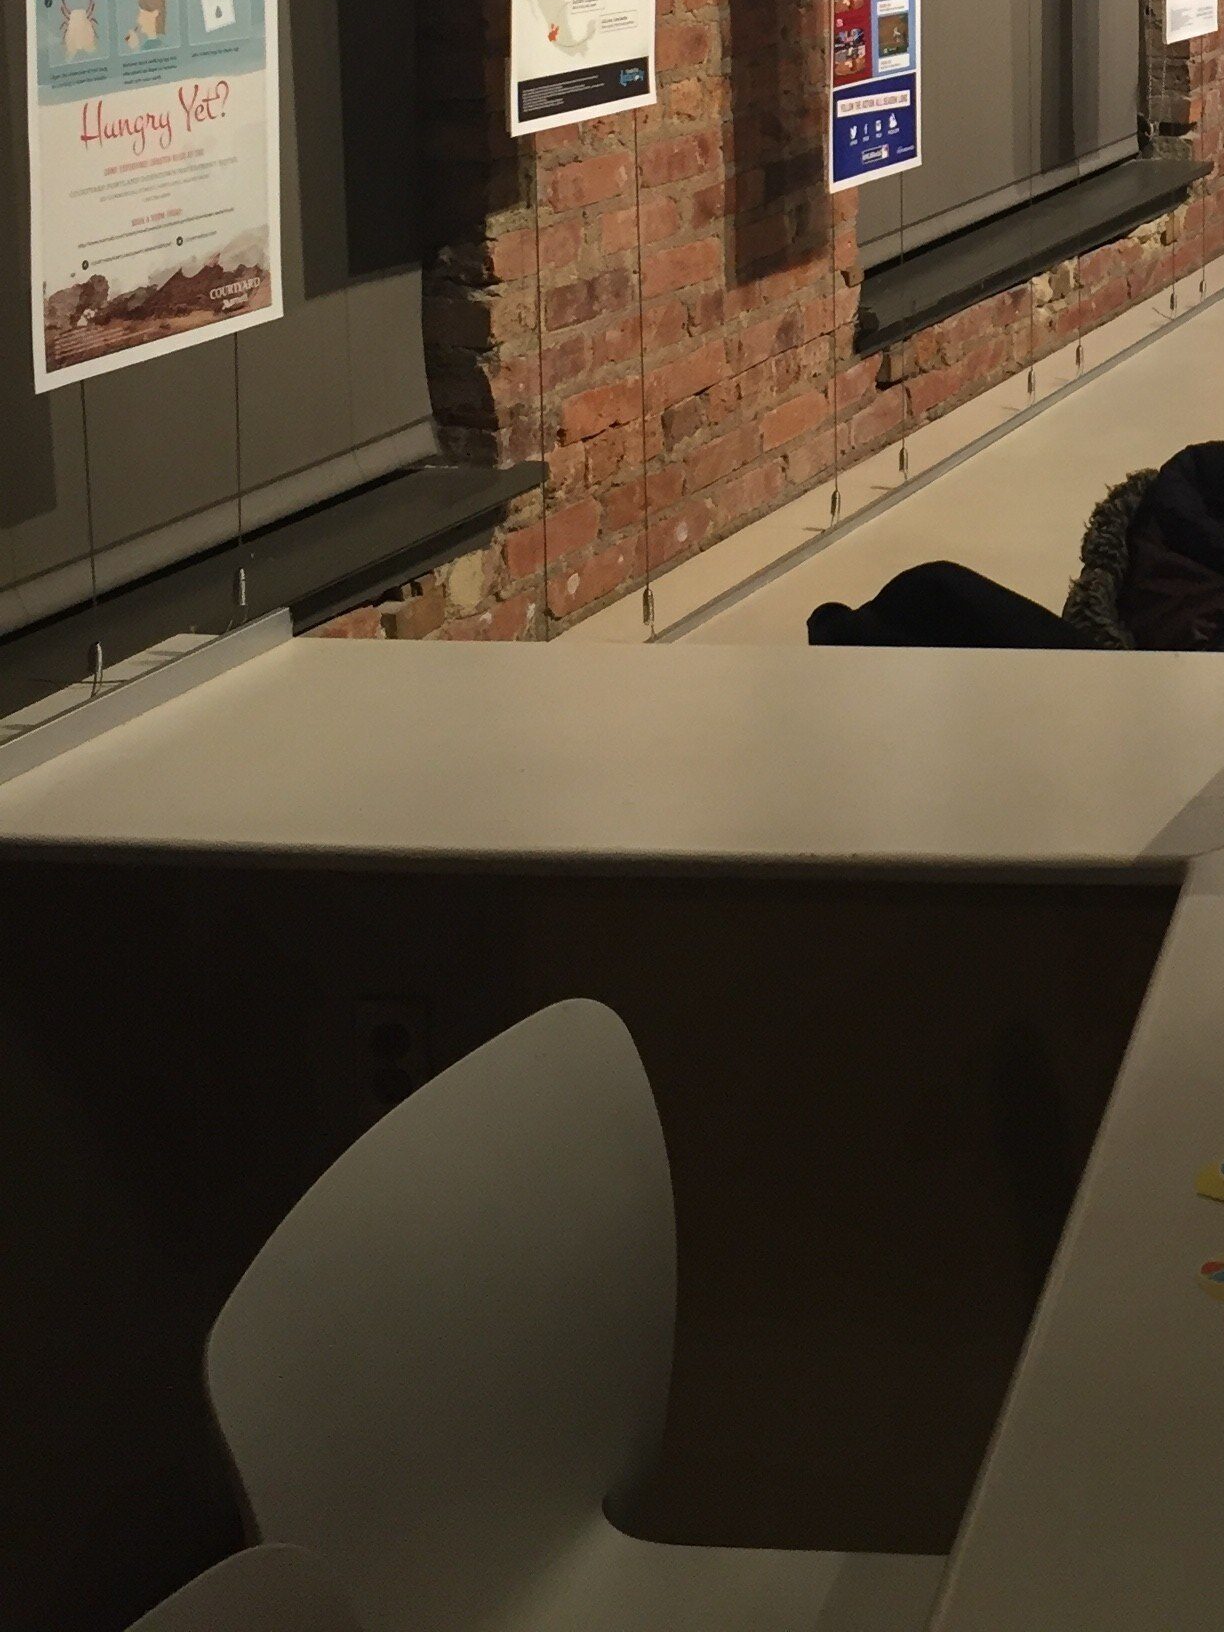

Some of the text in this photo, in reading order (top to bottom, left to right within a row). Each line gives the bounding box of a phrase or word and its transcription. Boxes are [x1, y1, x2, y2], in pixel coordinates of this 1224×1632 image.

[80, 80, 230, 155] Hungry Yet?
[209, 277, 260, 300] COURTYARD
